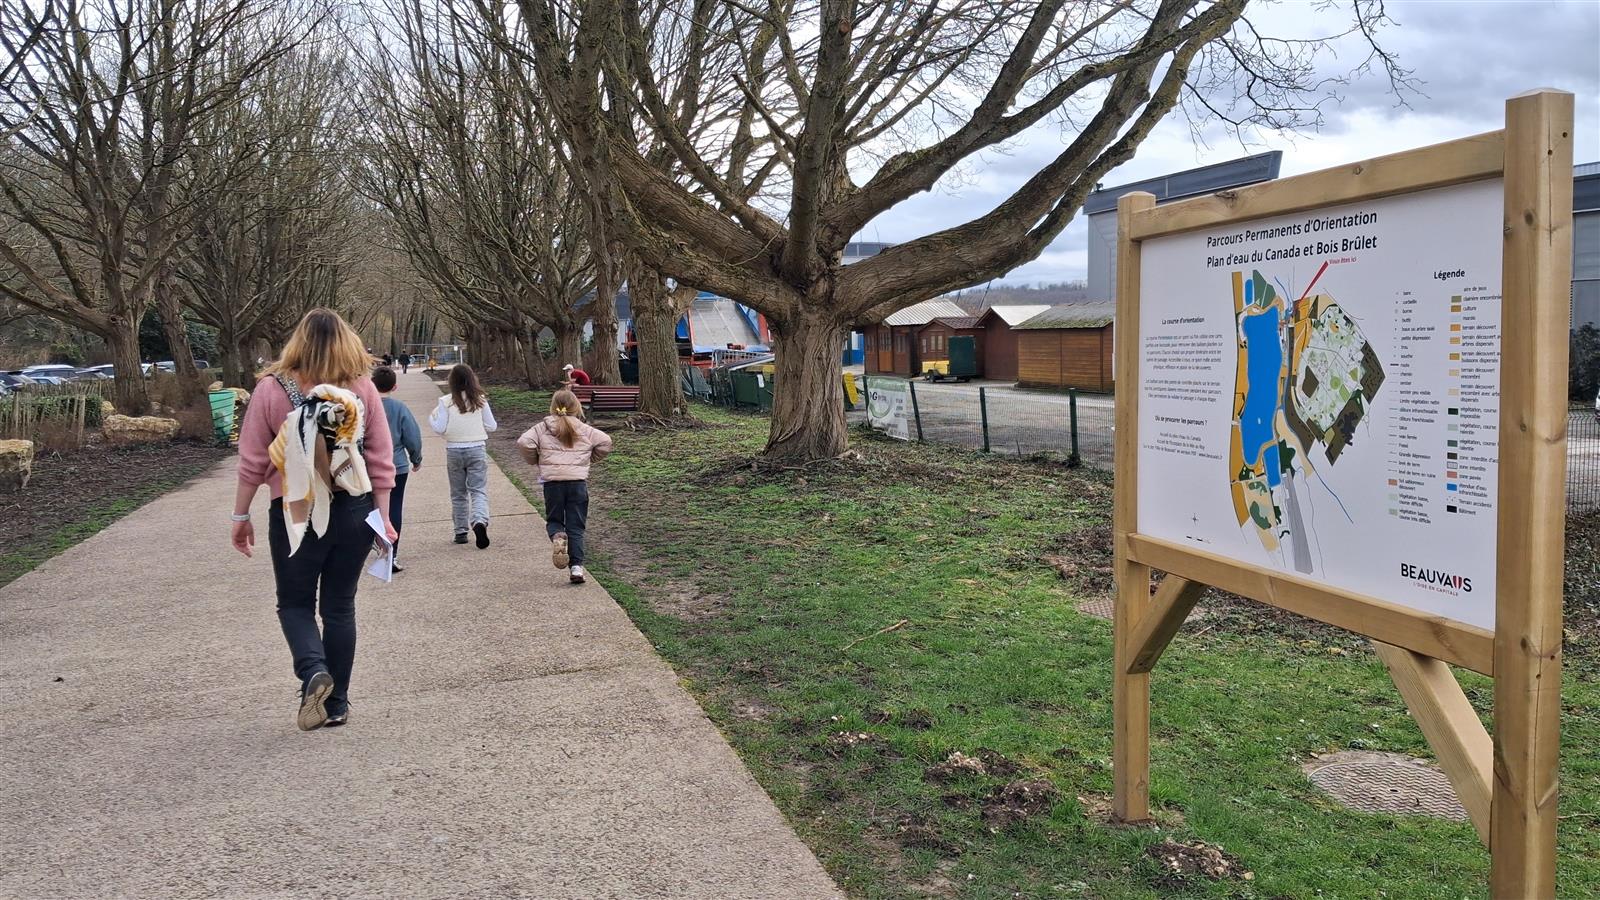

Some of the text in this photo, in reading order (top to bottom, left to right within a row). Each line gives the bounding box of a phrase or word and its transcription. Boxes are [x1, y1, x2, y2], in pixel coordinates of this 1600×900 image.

[1207, 211, 1377, 248] Parcours Permanents d'Orientation
[1207, 235, 1377, 268] Plan d'eau du Canada et Bois Brûlet
[1433, 268, 1465, 281] Légende
